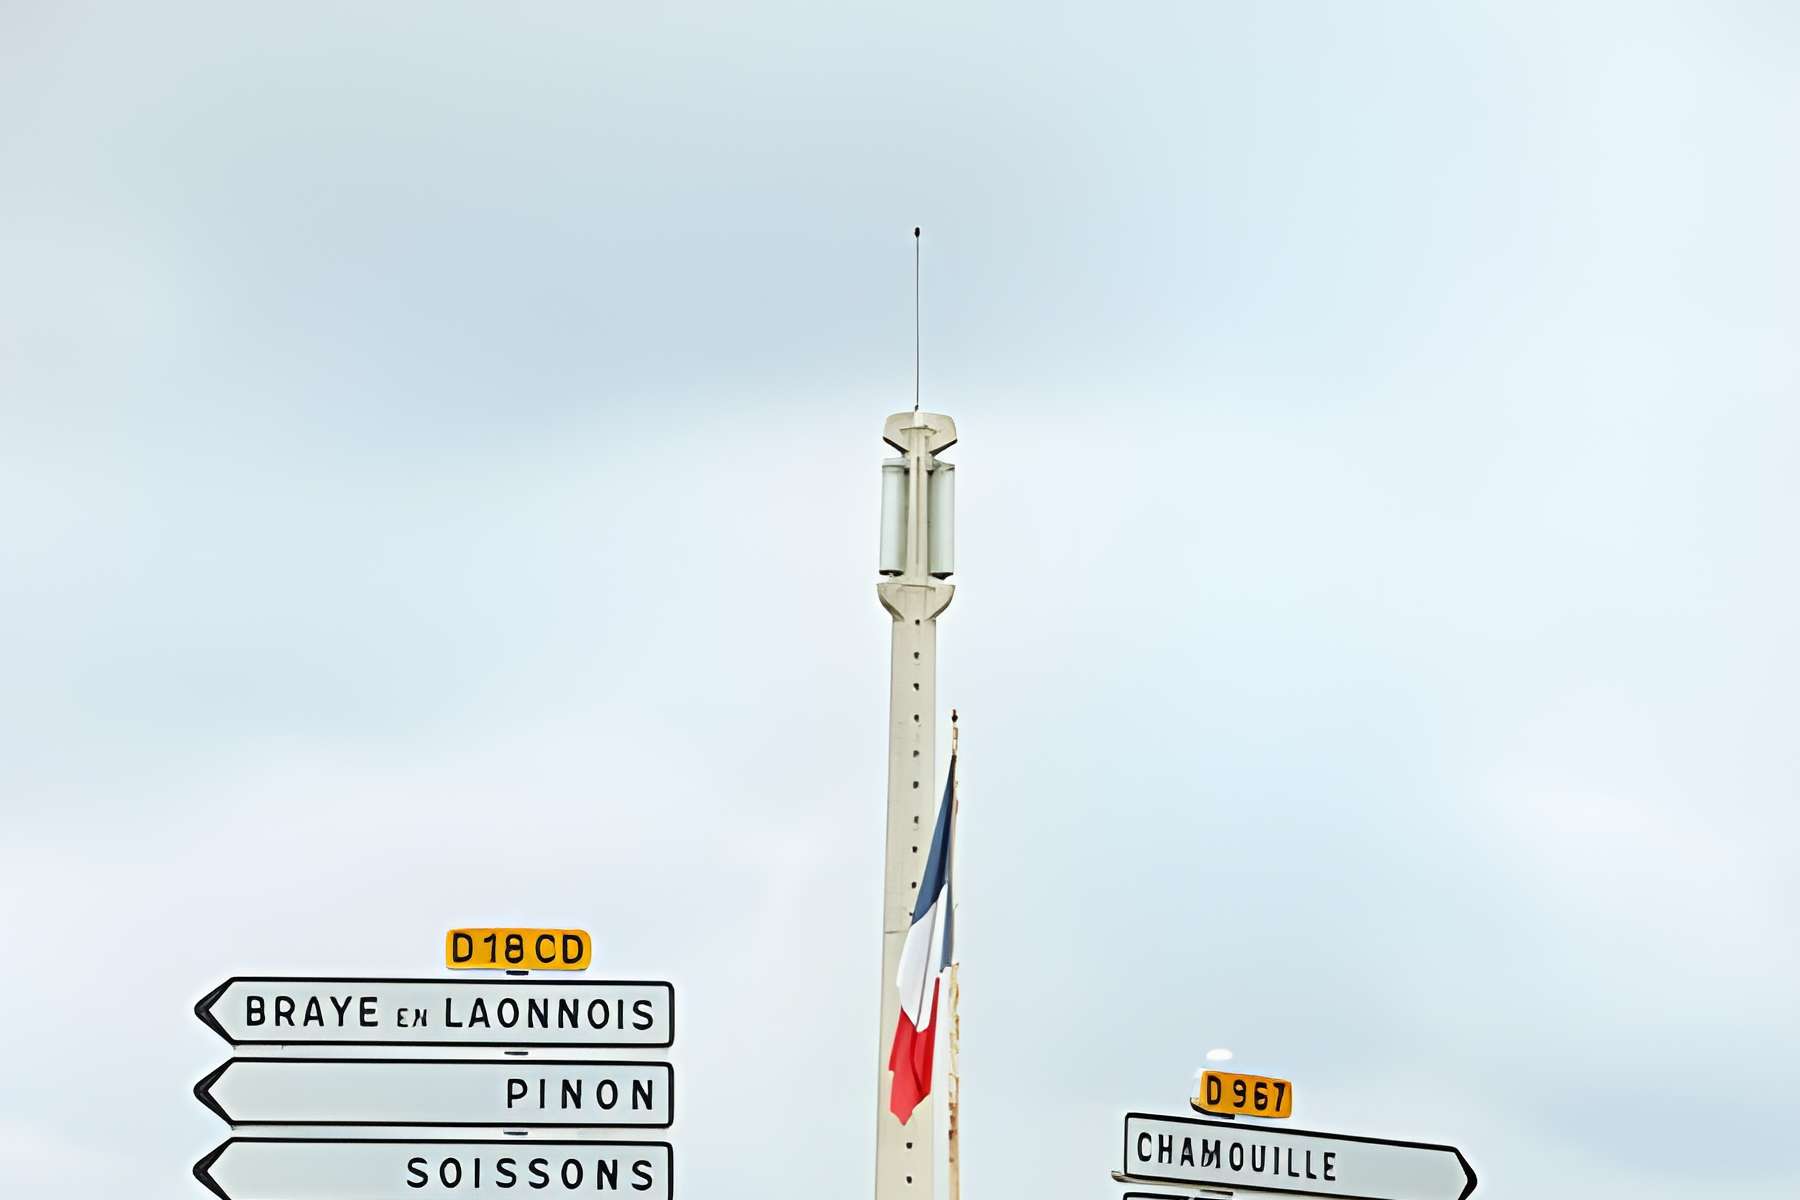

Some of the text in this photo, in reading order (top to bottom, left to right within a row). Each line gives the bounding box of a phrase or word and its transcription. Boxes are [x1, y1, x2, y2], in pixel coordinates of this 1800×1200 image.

[246, 995, 654, 1031] BRAYE EN LAONNOIS
[507, 1078, 653, 1111] PINON
[406, 1156, 653, 1192] SOISSONS
[1136, 1131, 1337, 1182] CHAMOUILLE
